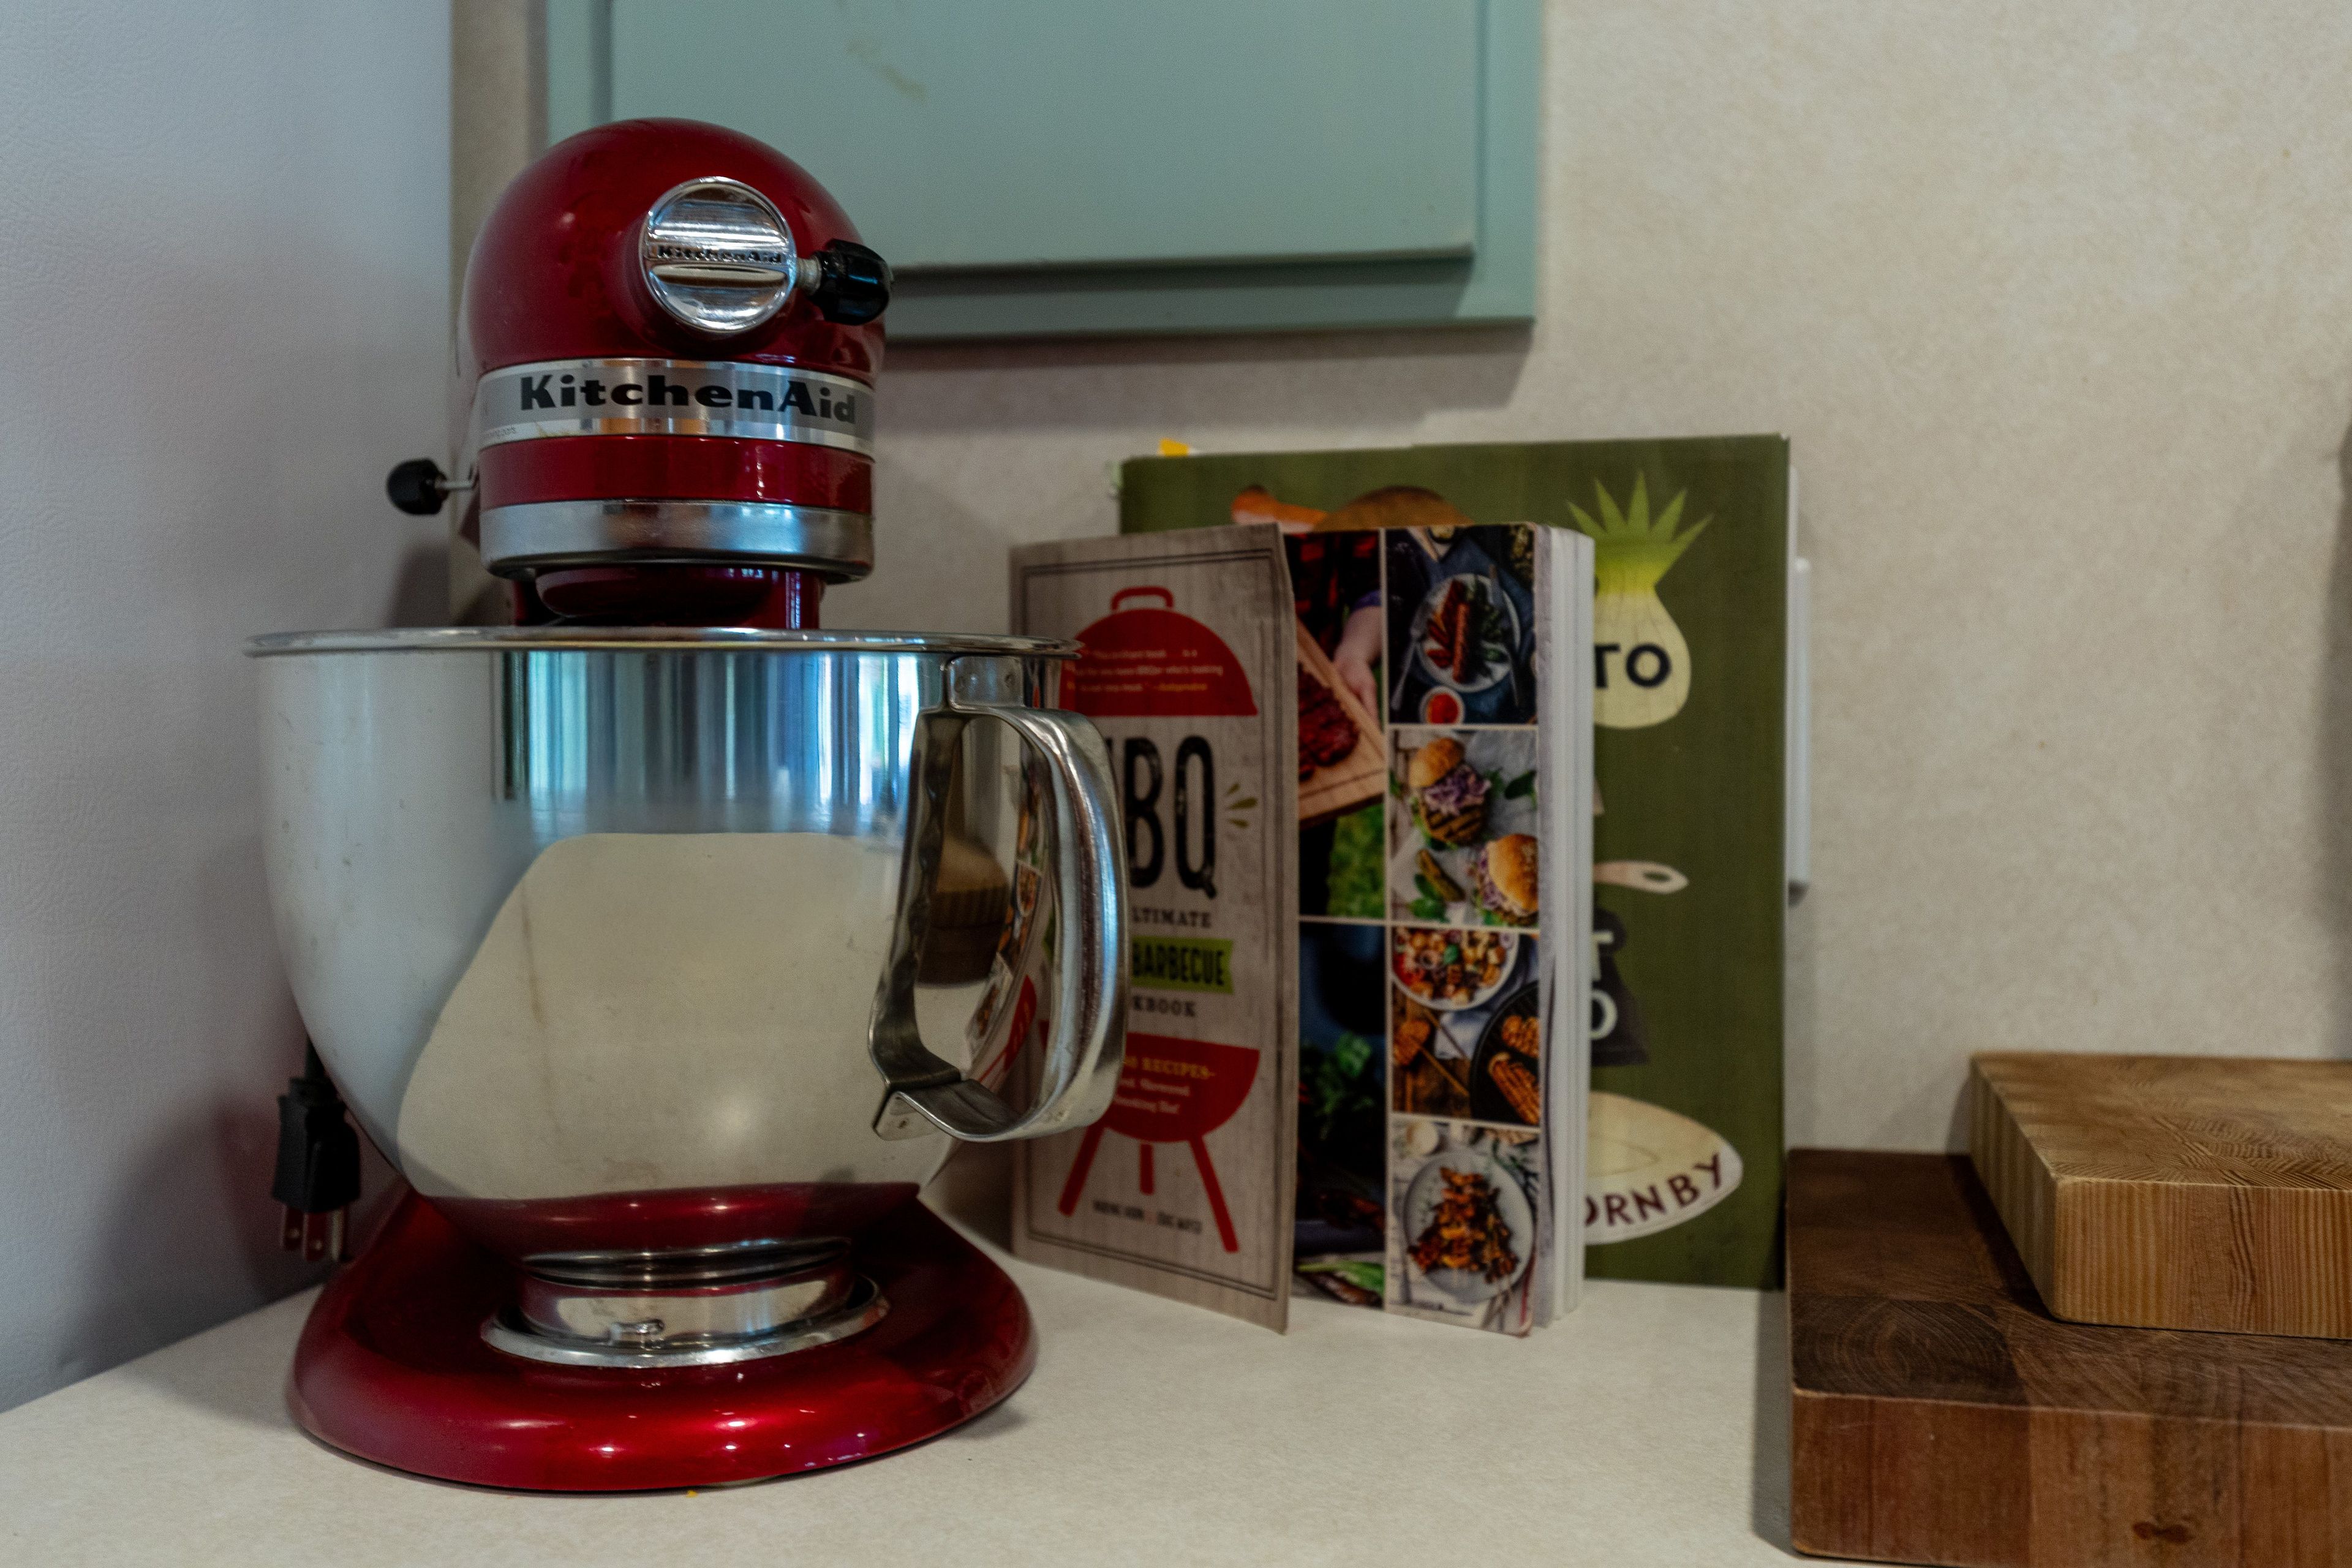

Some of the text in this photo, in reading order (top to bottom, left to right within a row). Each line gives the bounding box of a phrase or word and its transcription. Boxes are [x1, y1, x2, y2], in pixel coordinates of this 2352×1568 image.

[657, 244, 782, 263] KitchenAid
[519, 374, 856, 426] KitchenAid
[1594, 643, 1672, 695] TO
[1104, 735, 1217, 899] BQ
